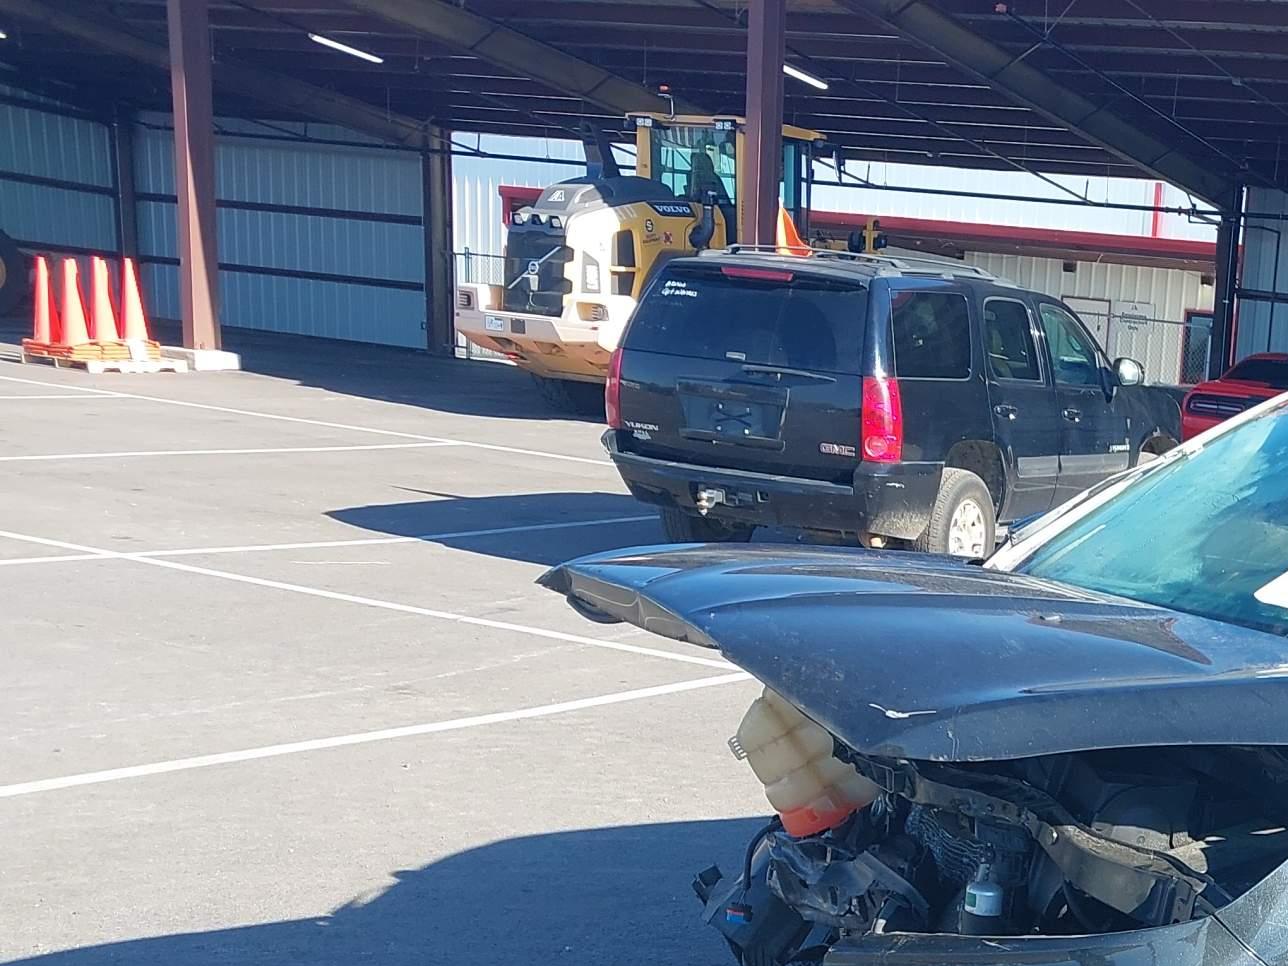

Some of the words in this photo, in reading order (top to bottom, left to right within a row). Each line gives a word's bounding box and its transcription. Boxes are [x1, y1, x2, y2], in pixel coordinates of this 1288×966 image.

[654, 205, 690, 213] VOLVO
[624, 420, 659, 431] YUKON
[819, 442, 856, 457] GMC
